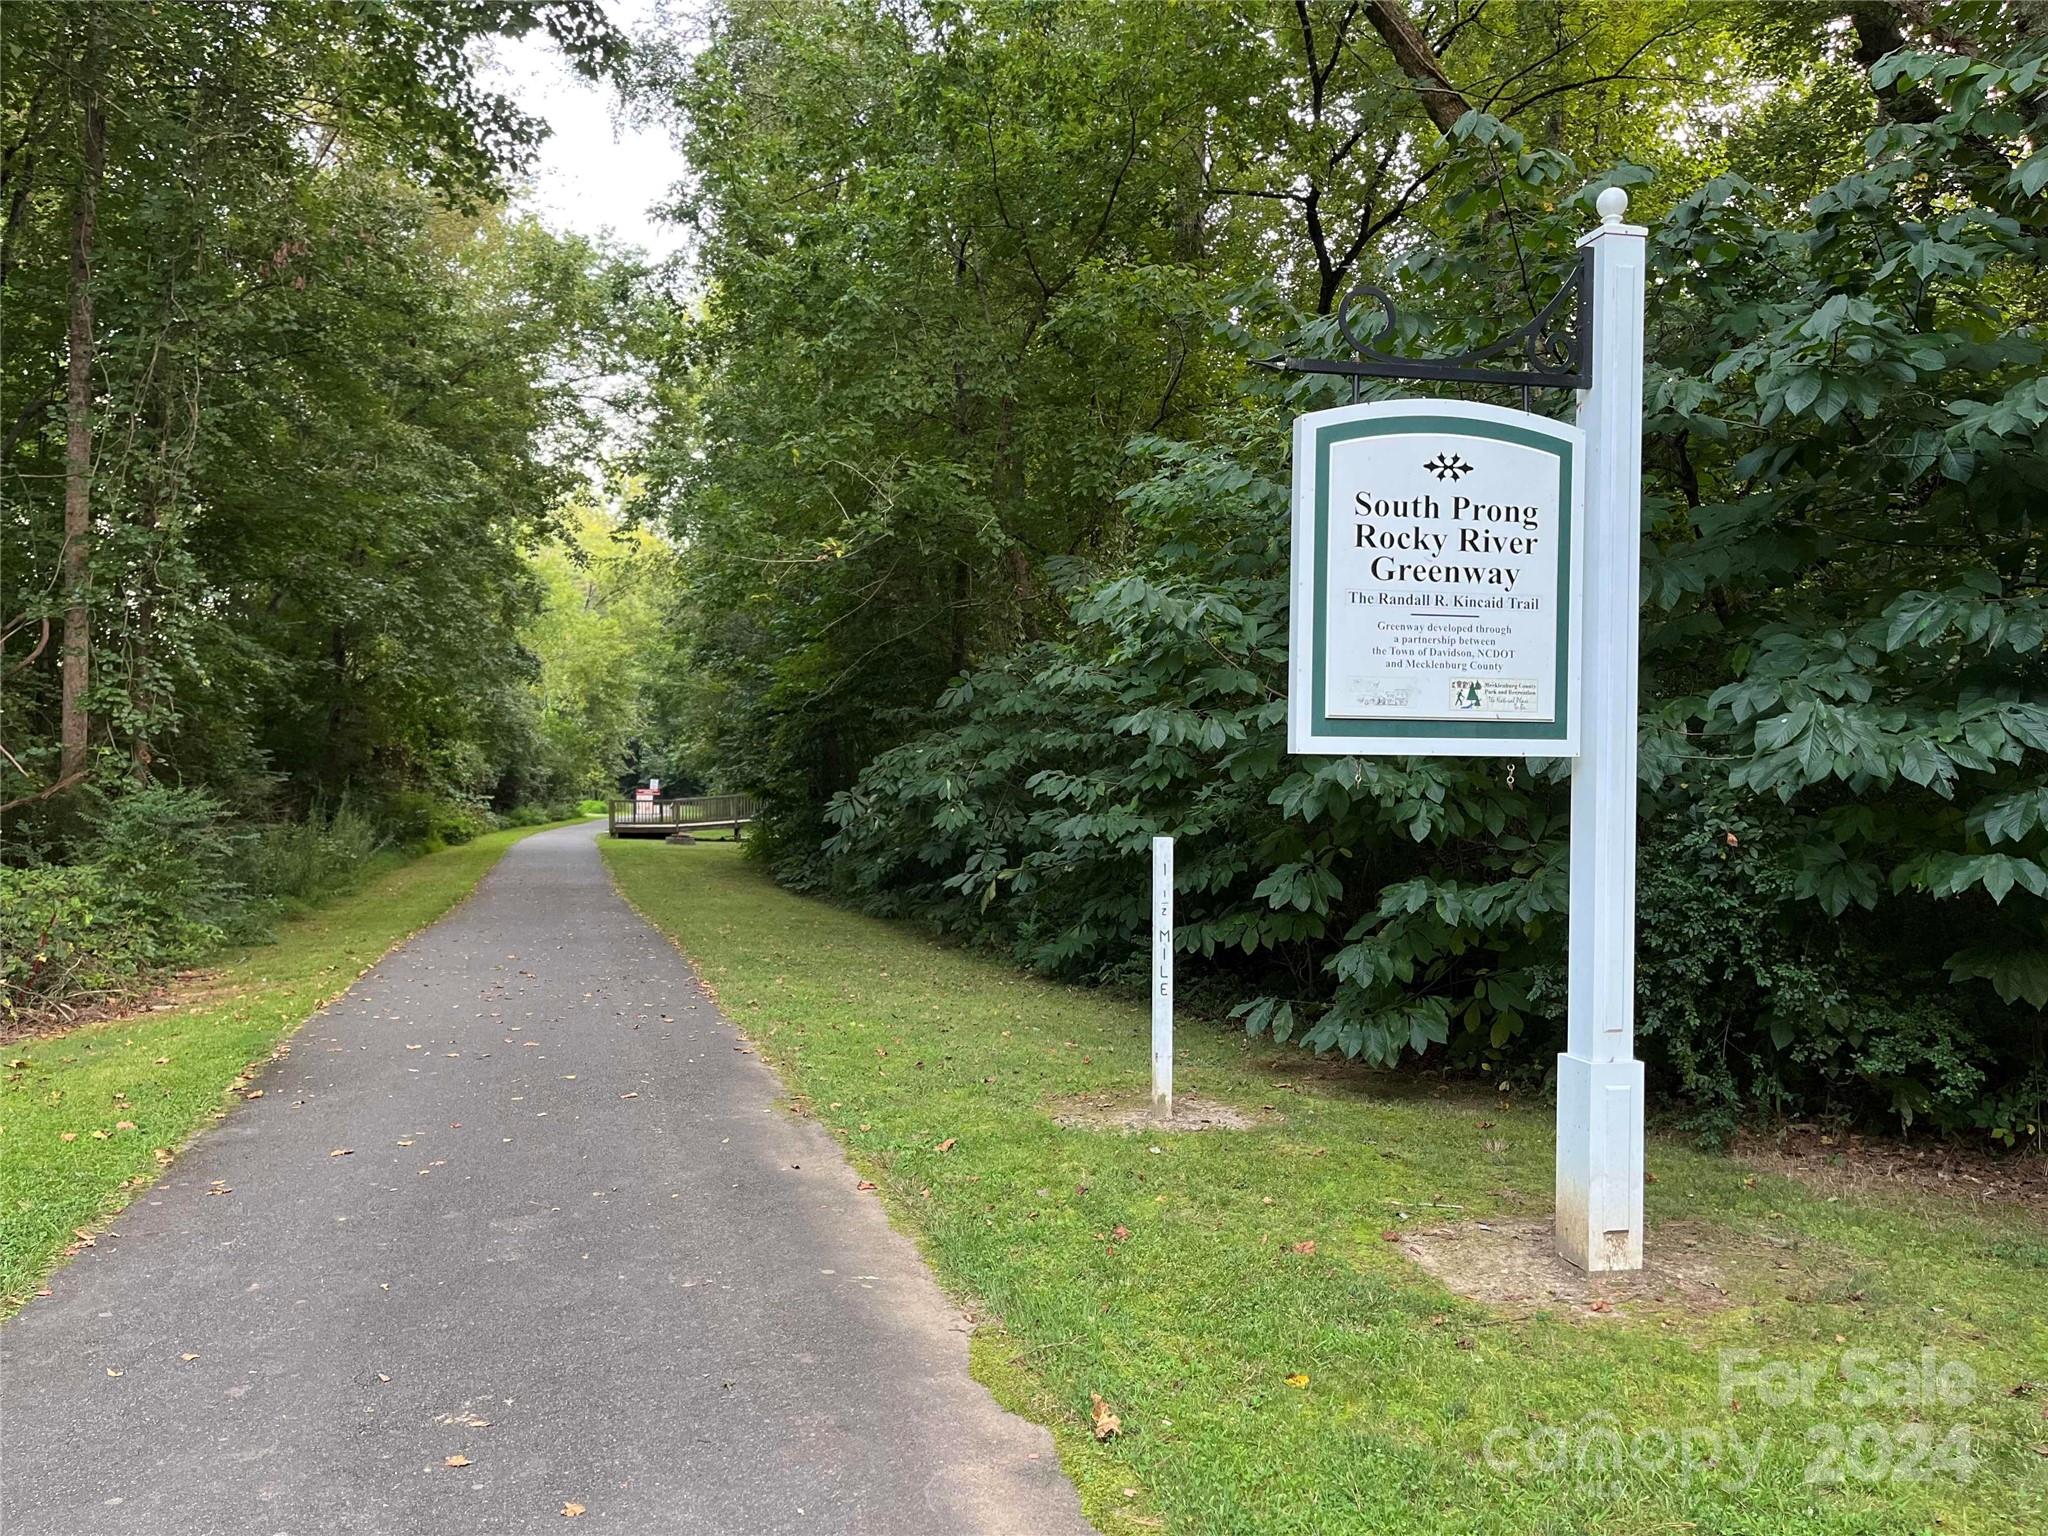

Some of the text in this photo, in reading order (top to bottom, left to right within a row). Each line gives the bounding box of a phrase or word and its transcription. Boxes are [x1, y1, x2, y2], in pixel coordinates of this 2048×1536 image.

[1355, 491, 1539, 530] South Prong
[1354, 523, 1538, 557] Rocky River
[1371, 556, 1520, 592] Greenway
[1349, 591, 1539, 610] The Randall R. Kincaid Trail
[1377, 621, 1512, 635] Greenway developed through
[1402, 636, 1456, 646] partnership
[1459, 637, 1496, 646] between
[1372, 646, 1515, 659] the Town of Davidson, NCDOT
[1386, 659, 1504, 673] and Mecklenburg County
[1159, 929, 1171, 996] MILE
